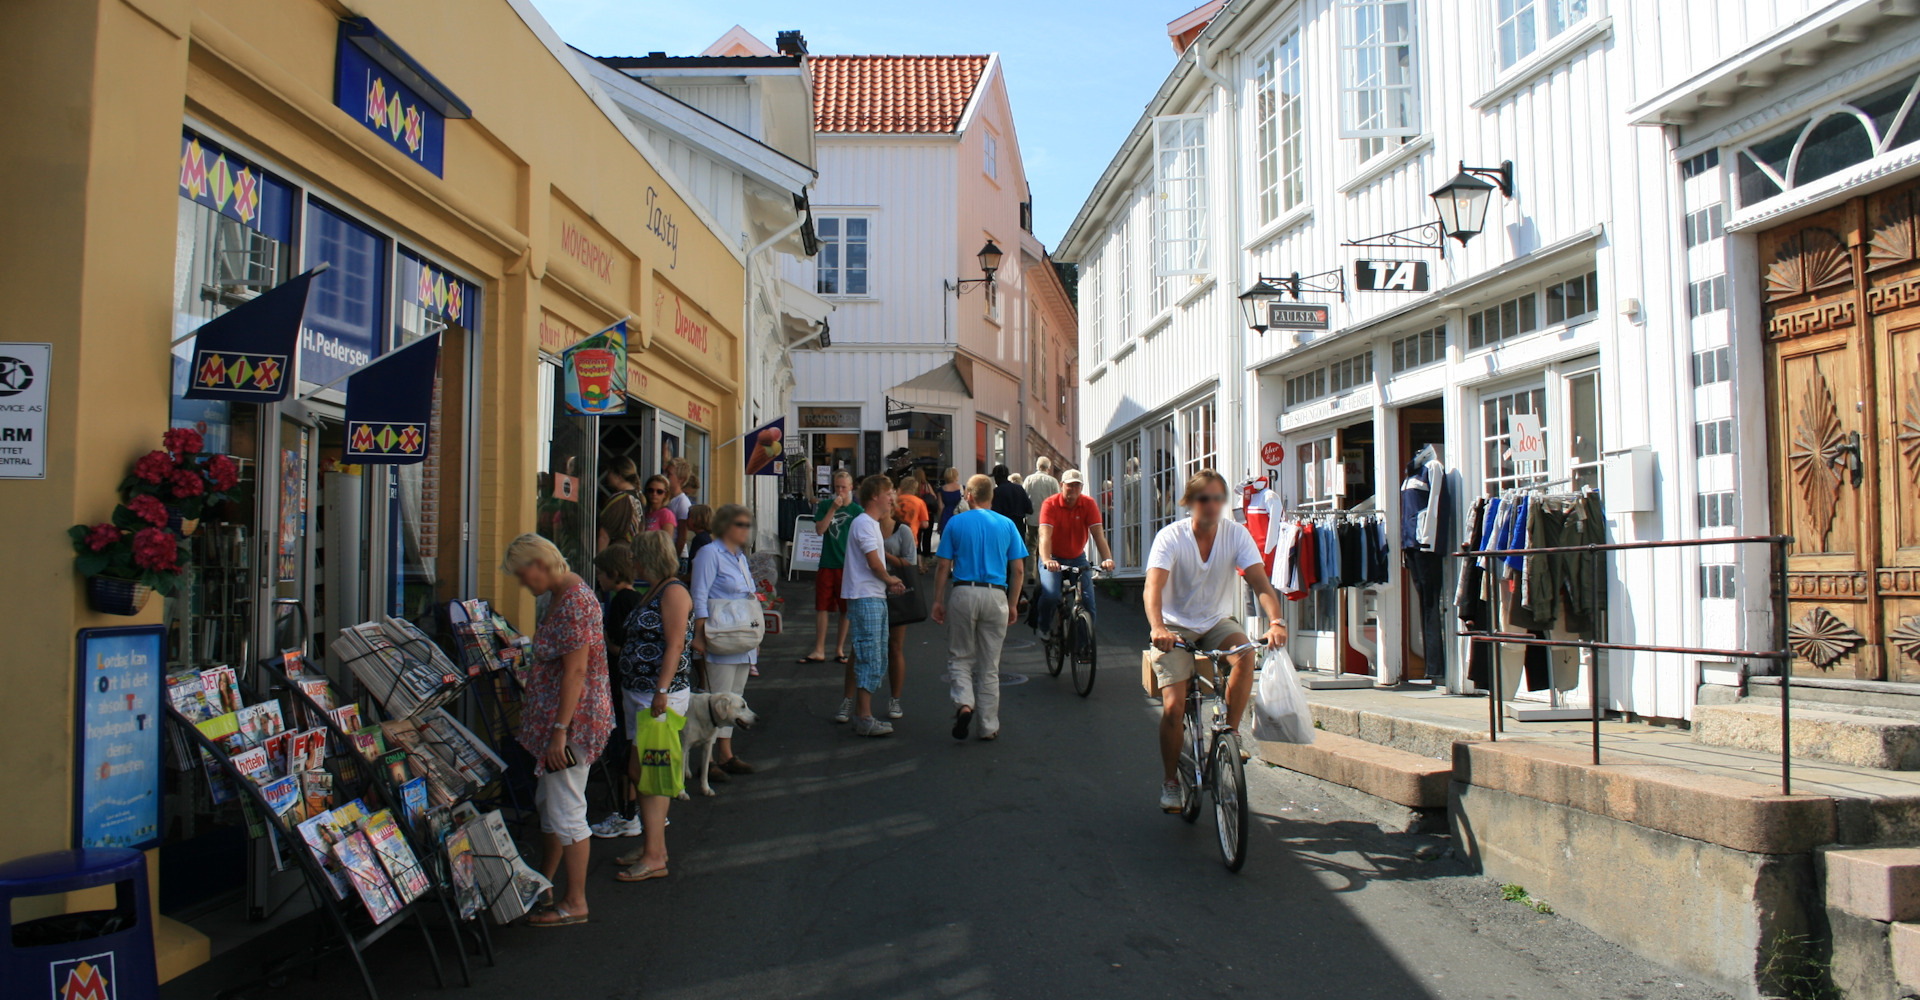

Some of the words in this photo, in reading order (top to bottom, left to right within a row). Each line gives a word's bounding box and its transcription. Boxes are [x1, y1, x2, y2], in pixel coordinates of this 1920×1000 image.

[368, 80, 421, 151] MIX
[180, 141, 257, 221] MIX
[646, 186, 679, 270] Tasty
[1368, 261, 1416, 290] TA
[418, 266, 461, 319] MIX
[1274, 310, 1318, 322] PAULSEN
[303, 327, 369, 367] H.Pedersen
[199, 356, 280, 389] MIX
[28, 404, 42, 413] AS
[0, 428, 33, 442] RM
[351, 426, 421, 451] MIX
[201, 673, 219, 691] DET
[356, 732, 374, 748] tara
[385, 752, 407, 765] CONAN
[265, 783, 292, 803] hytte
